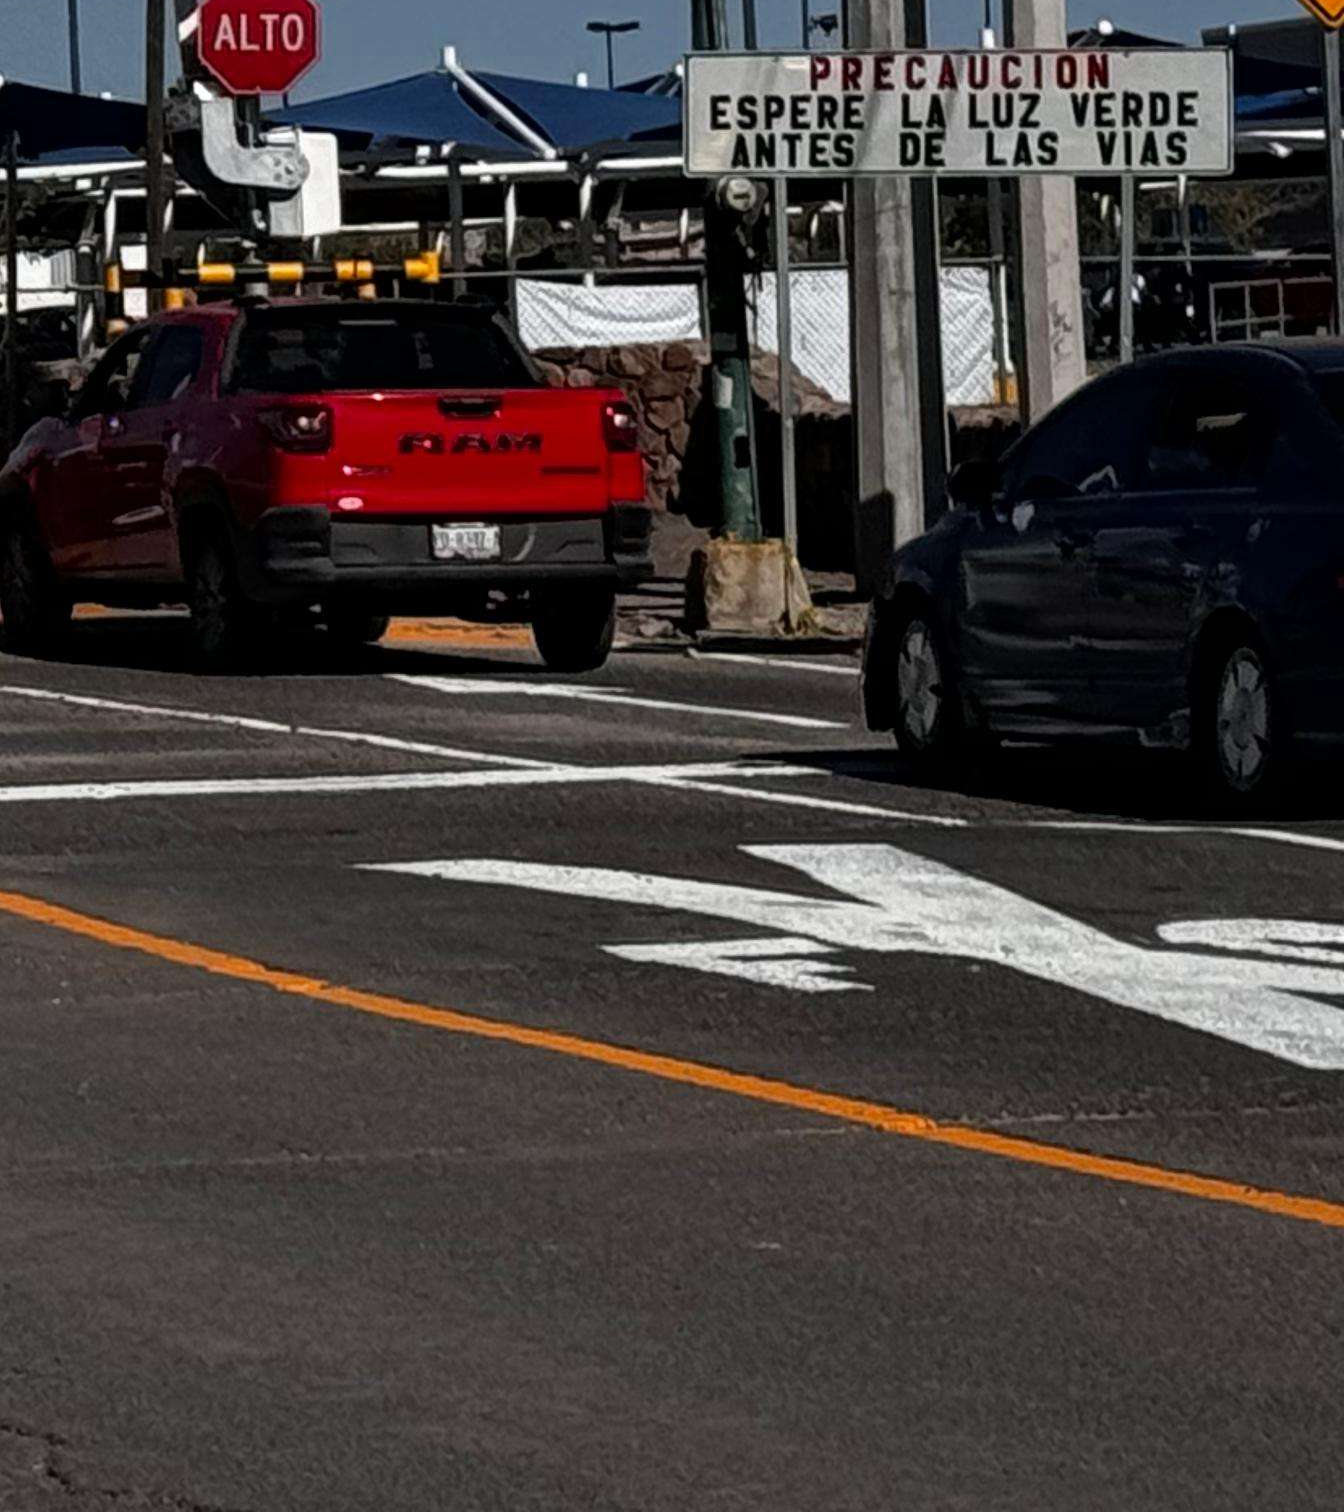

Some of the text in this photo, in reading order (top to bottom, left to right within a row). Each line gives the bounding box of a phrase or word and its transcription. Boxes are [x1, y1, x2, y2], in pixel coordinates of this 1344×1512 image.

[213, 13, 304, 52] ALTO
[812, 54, 1110, 91] PRECAUCION
[710, 90, 1199, 130] ESPERE LA LUZ VERDE
[730, 129, 1188, 169] ANTES DE LAS VIAS
[398, 432, 541, 455] RAM
